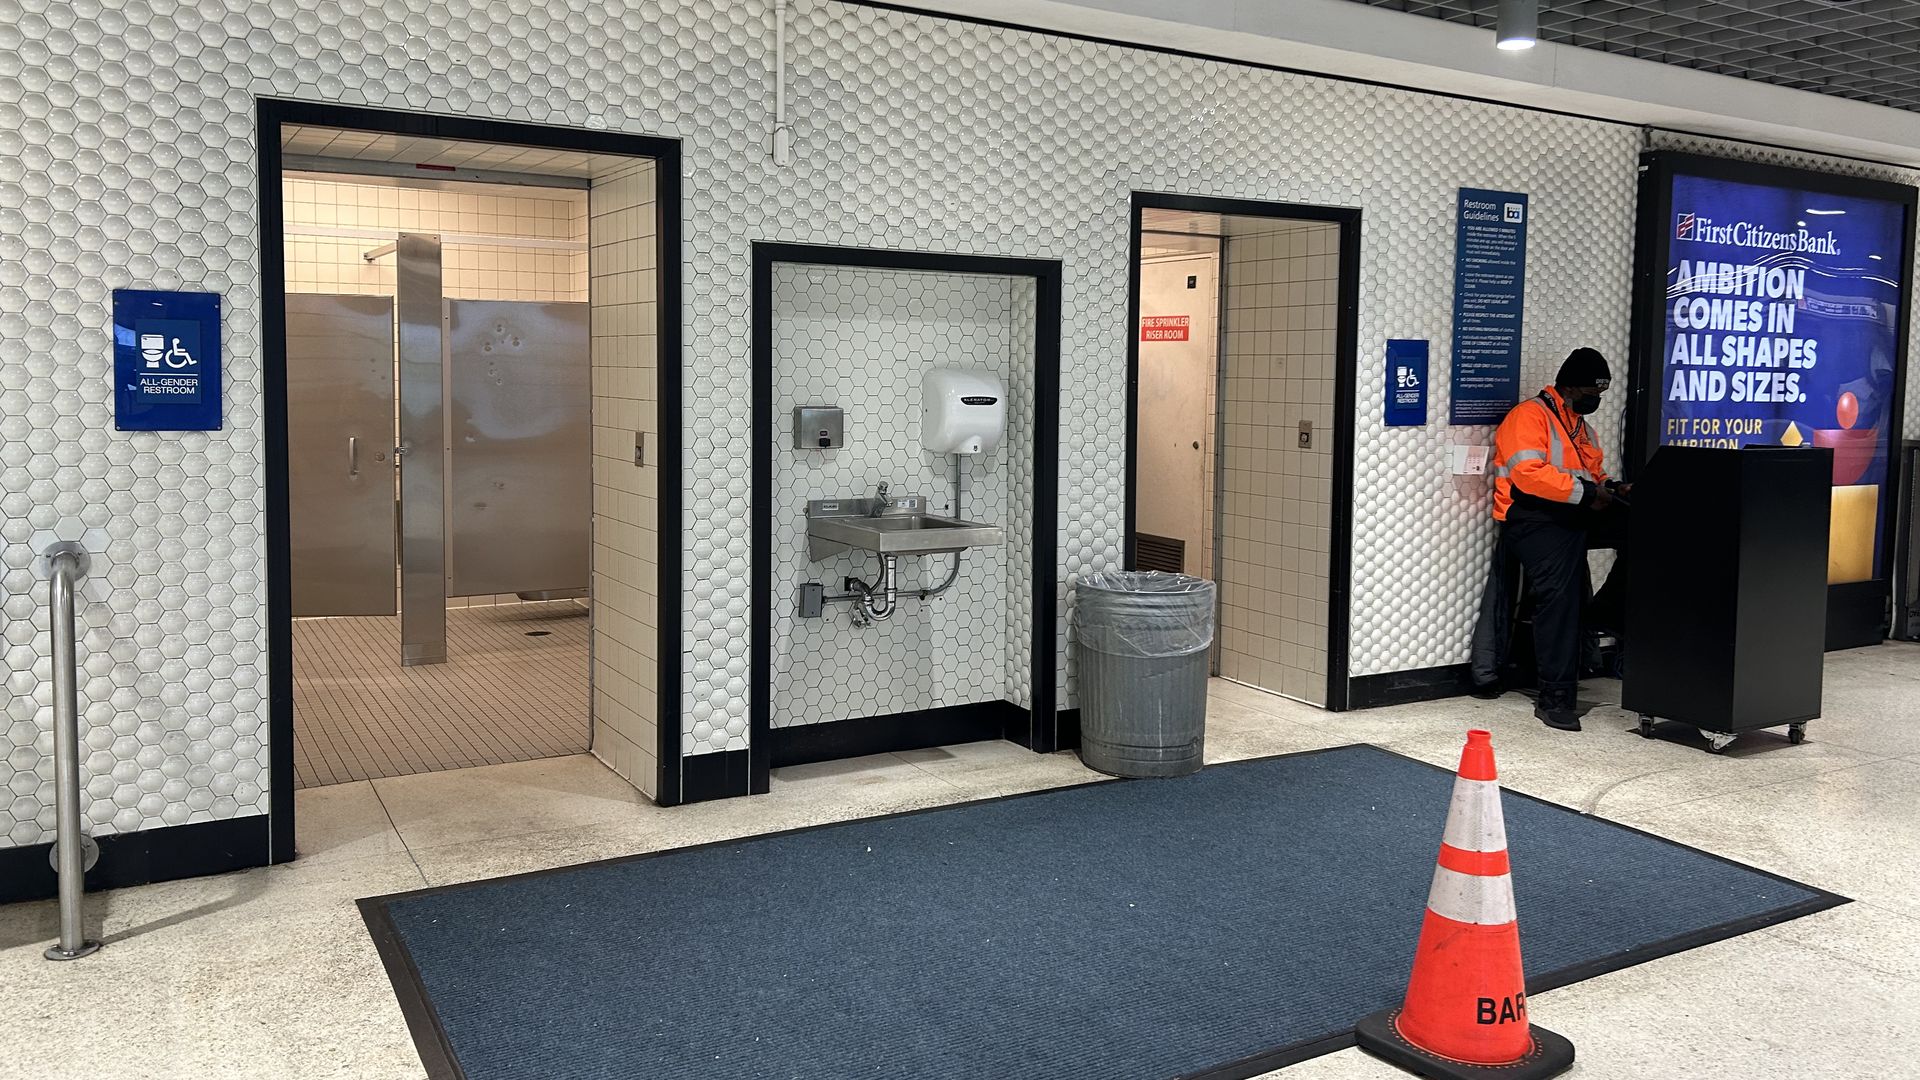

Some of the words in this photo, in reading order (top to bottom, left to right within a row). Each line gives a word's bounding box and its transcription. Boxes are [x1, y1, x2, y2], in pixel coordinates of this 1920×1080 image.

[1464, 200, 1496, 210] Restroom
[1464, 210, 1499, 222] Guidelines
[1675, 260, 1805, 299] AMBITION
[1673, 298, 1762, 332] COMES
[1767, 303, 1795, 333] IN
[1142, 318, 1155, 327] FIRE
[1156, 318, 1189, 327] SPRINKLER
[1146, 330, 1163, 339] RISER
[1164, 330, 1183, 339] ROOM
[1671, 333, 1717, 366] ALL
[1720, 336, 1817, 369] SHAPES
[140, 378, 198, 386] ALL-GENDER
[1668, 370, 1726, 401] AND
[1731, 371, 1806, 402] SIZES.
[144, 386, 195, 394] RESTROOM
[1667, 418, 1688, 435] FIT
[1692, 418, 1720, 435] FOR
[1724, 418, 1762, 435] YOUR
